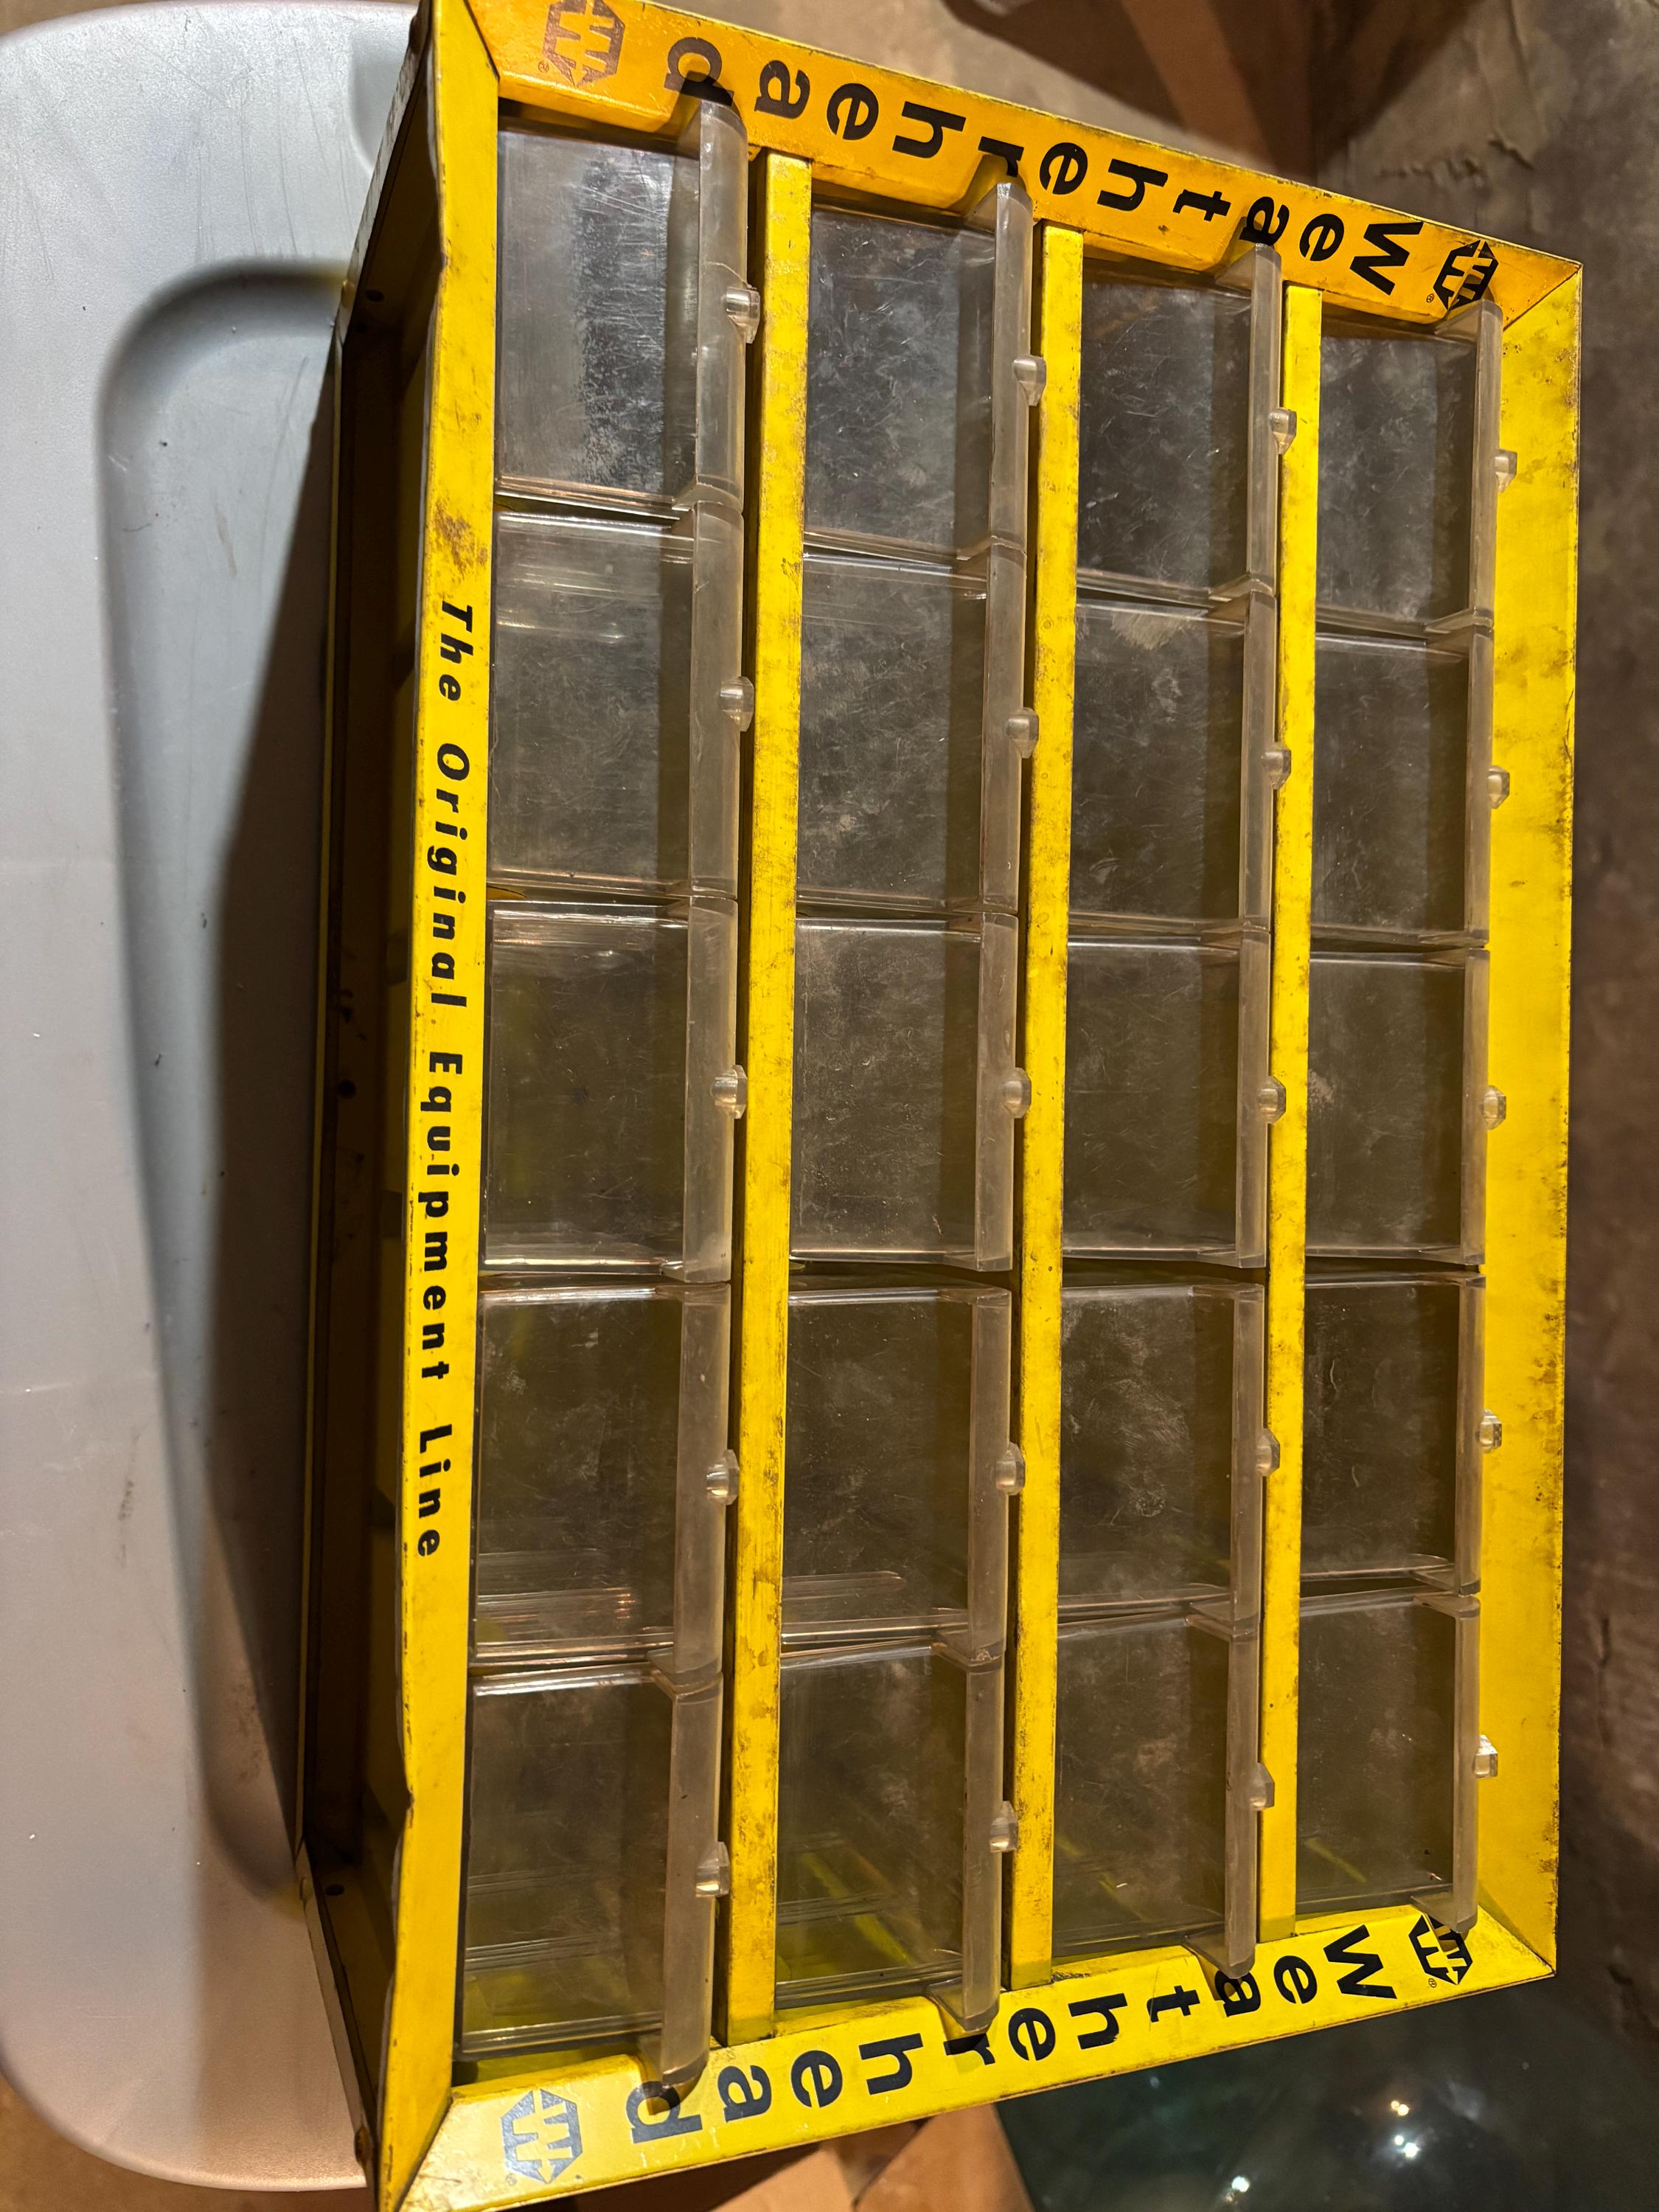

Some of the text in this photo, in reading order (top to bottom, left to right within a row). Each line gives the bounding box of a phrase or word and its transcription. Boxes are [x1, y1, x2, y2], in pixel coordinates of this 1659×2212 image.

[664, 36, 1424, 296] Weatherhead
[417, 599, 473, 1557] The Original Equipment Line
[626, 1924, 1397, 2143] Weatherhead
